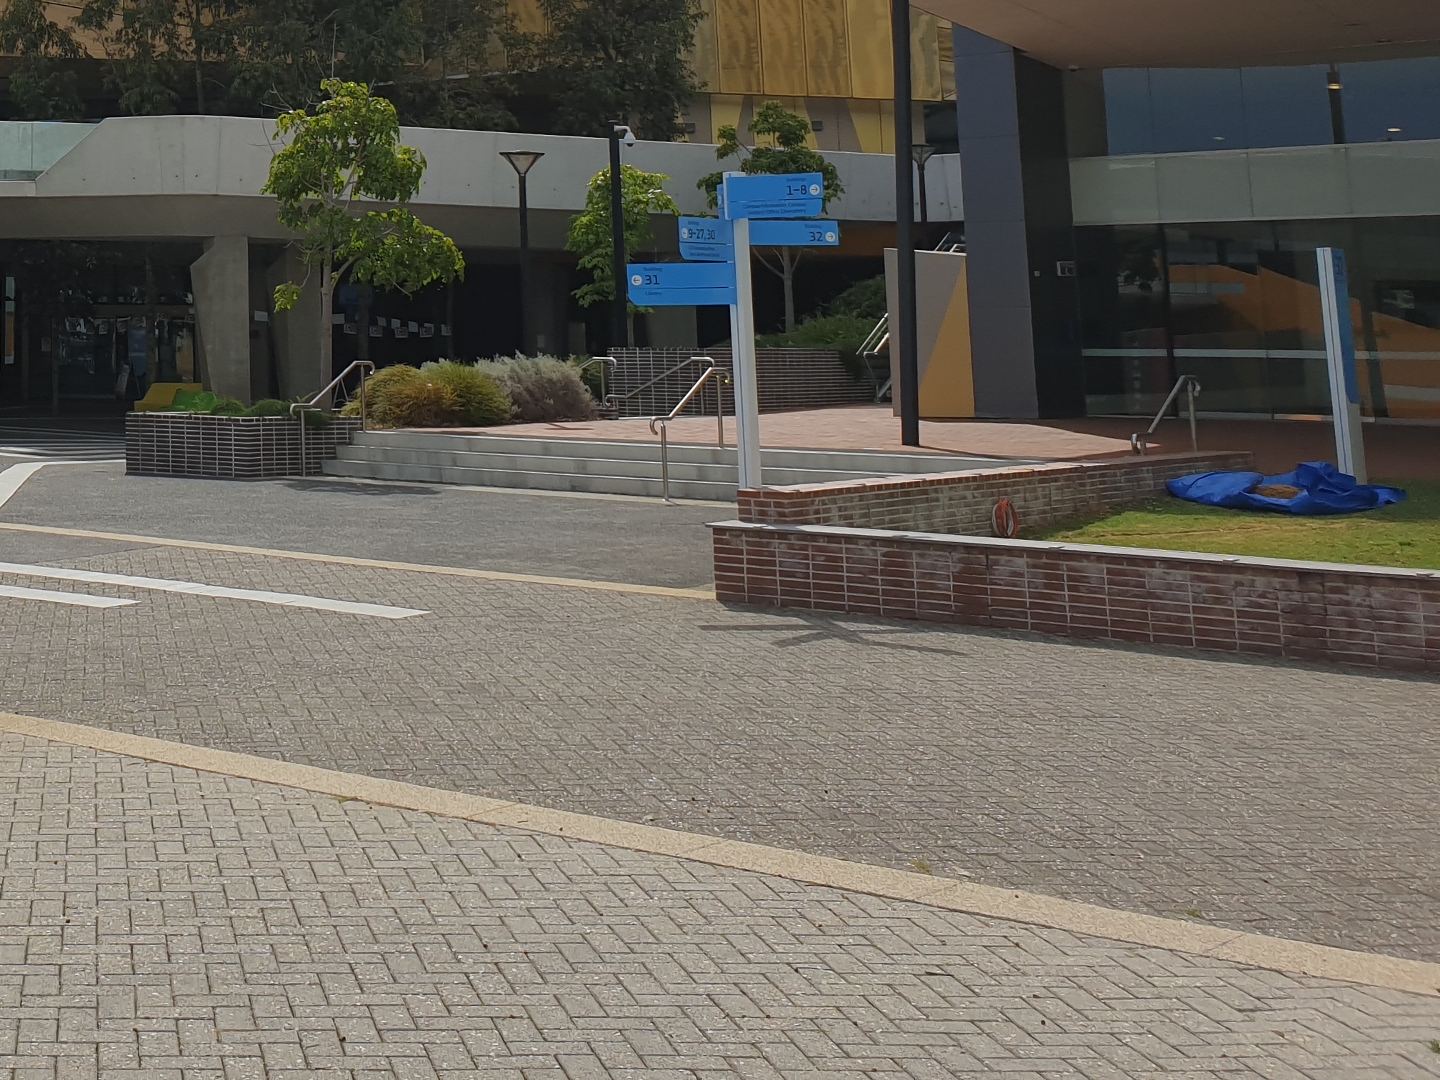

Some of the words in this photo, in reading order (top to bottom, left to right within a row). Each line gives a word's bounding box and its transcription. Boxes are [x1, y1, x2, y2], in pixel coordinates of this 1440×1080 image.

[786, 184, 807, 196] 1-8
[809, 231, 823, 242] 32
[644, 274, 660, 285] 31
